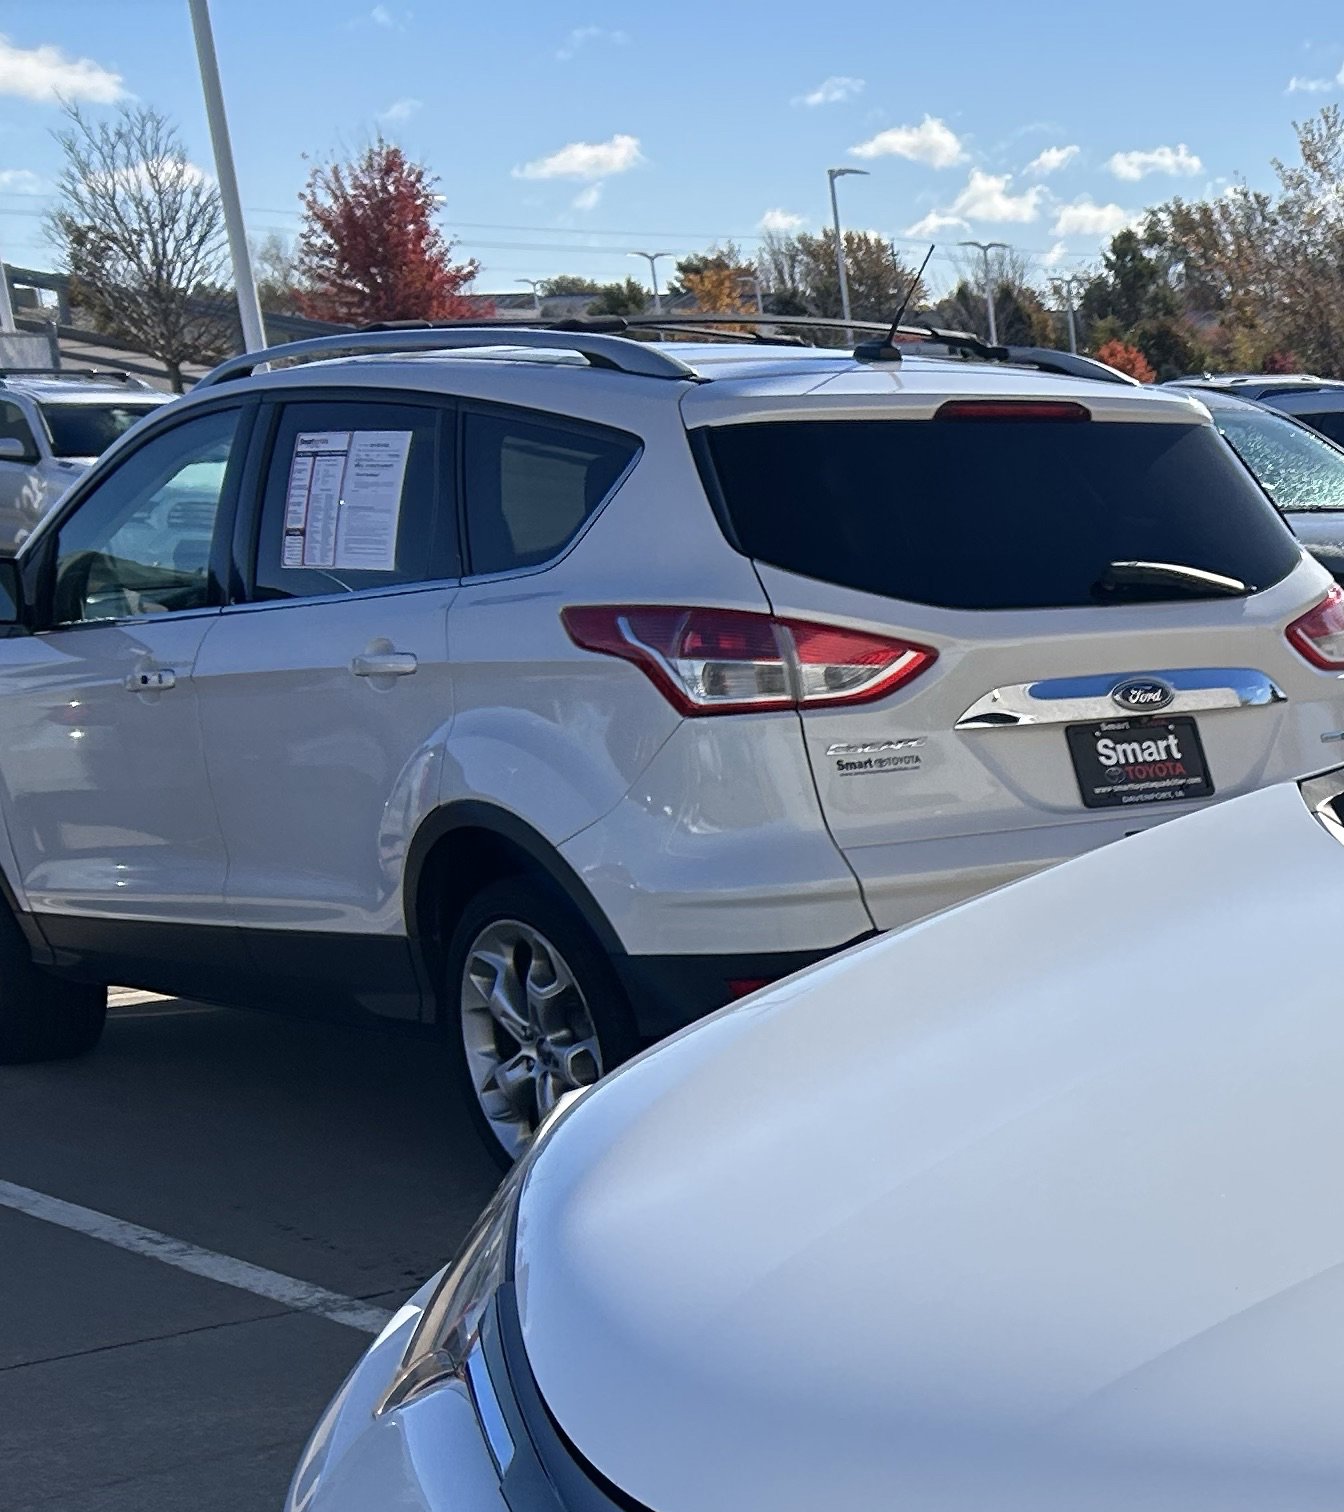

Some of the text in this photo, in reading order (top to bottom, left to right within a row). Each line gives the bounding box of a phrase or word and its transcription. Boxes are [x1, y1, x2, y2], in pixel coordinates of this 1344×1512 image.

[1127, 688, 1163, 704] Ford
[1095, 734, 1182, 766] Smart
[836, 755, 922, 771] Smart TOYOTA
[1125, 761, 1186, 780] TOYOTA
